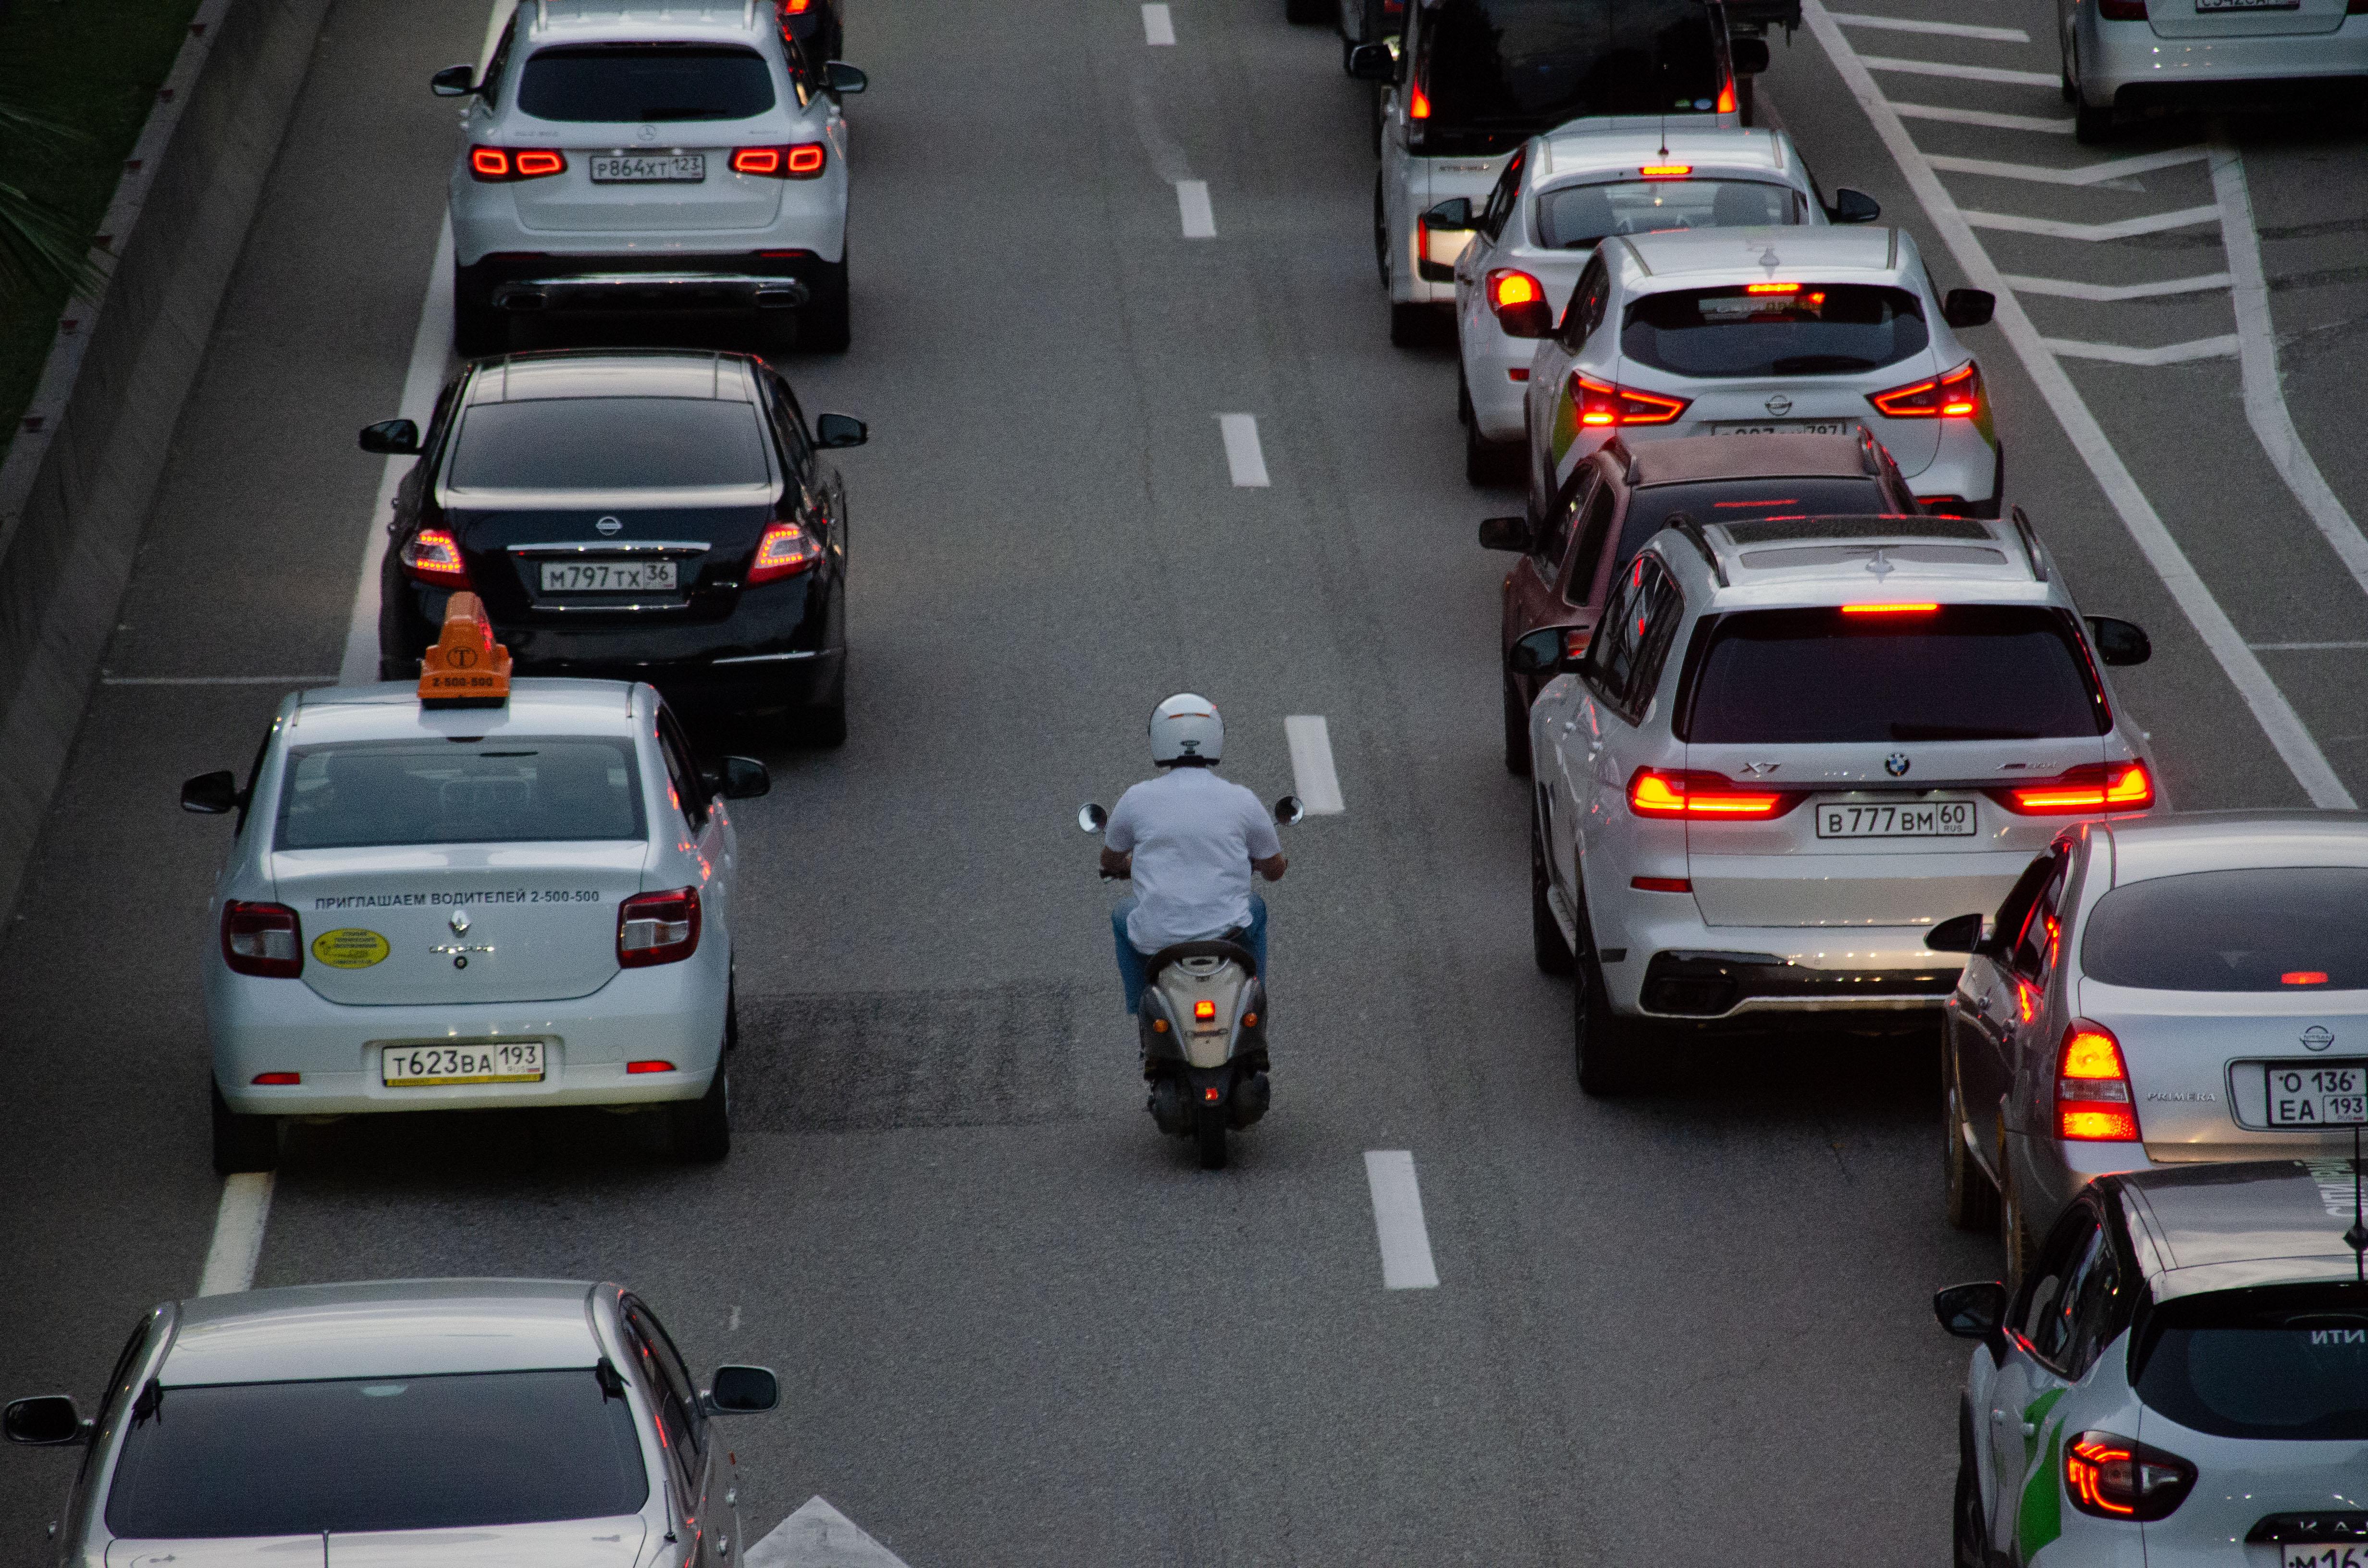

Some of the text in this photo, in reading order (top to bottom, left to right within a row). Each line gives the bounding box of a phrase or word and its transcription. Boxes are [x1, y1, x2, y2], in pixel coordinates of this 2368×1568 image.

[646, 565, 668, 581] 36
[432, 677, 493, 687] 2-500-500
[1739, 761, 1781, 773] X7
[1940, 805, 1965, 823] 60
[316, 889, 599, 909] ПРИГЛАШАЕМ ВОДИТЕЛЕЙ 2-500-500
[393, 1046, 536, 1076] Т623ВА 193
[2310, 1071, 2353, 1093] 136
[2147, 1092, 2216, 1102] PRIMERA
[2330, 1098, 2363, 1114] 193
[2300, 1521, 2368, 1534] KA
